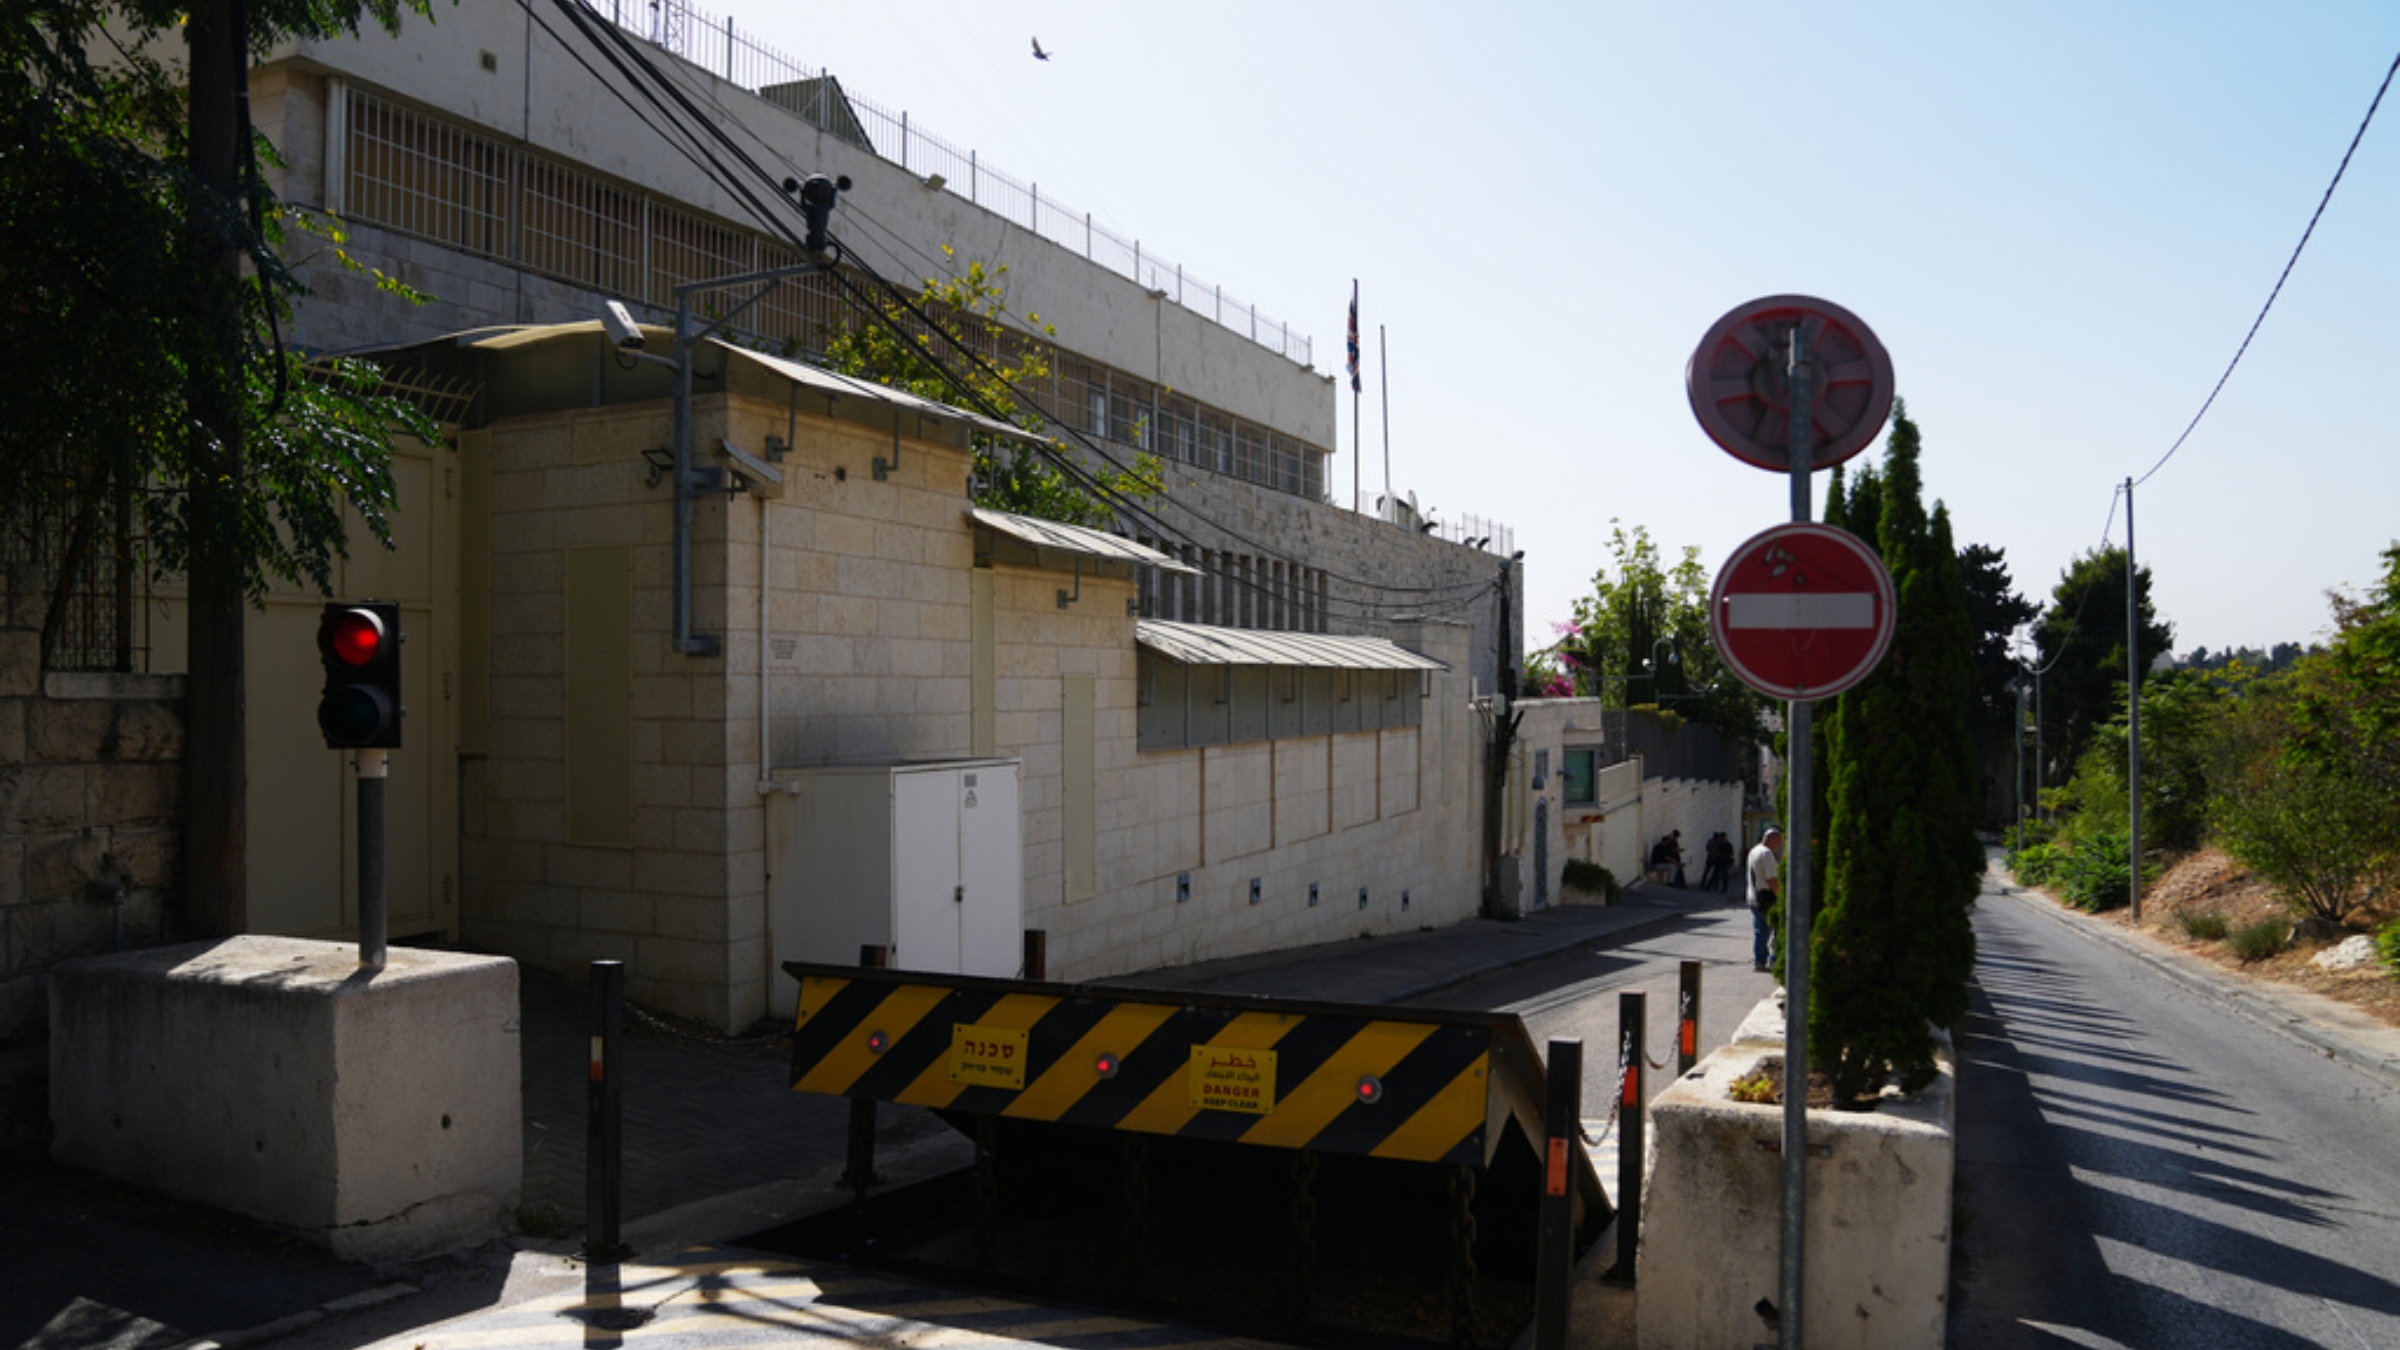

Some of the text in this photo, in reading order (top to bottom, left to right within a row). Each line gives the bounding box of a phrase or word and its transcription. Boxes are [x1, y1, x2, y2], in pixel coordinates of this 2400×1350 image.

[965, 1040, 1013, 1058] סכנה
[1204, 1083, 1259, 1098] DANGER
[1204, 1097, 1259, 1108] KEEP CLEAR
